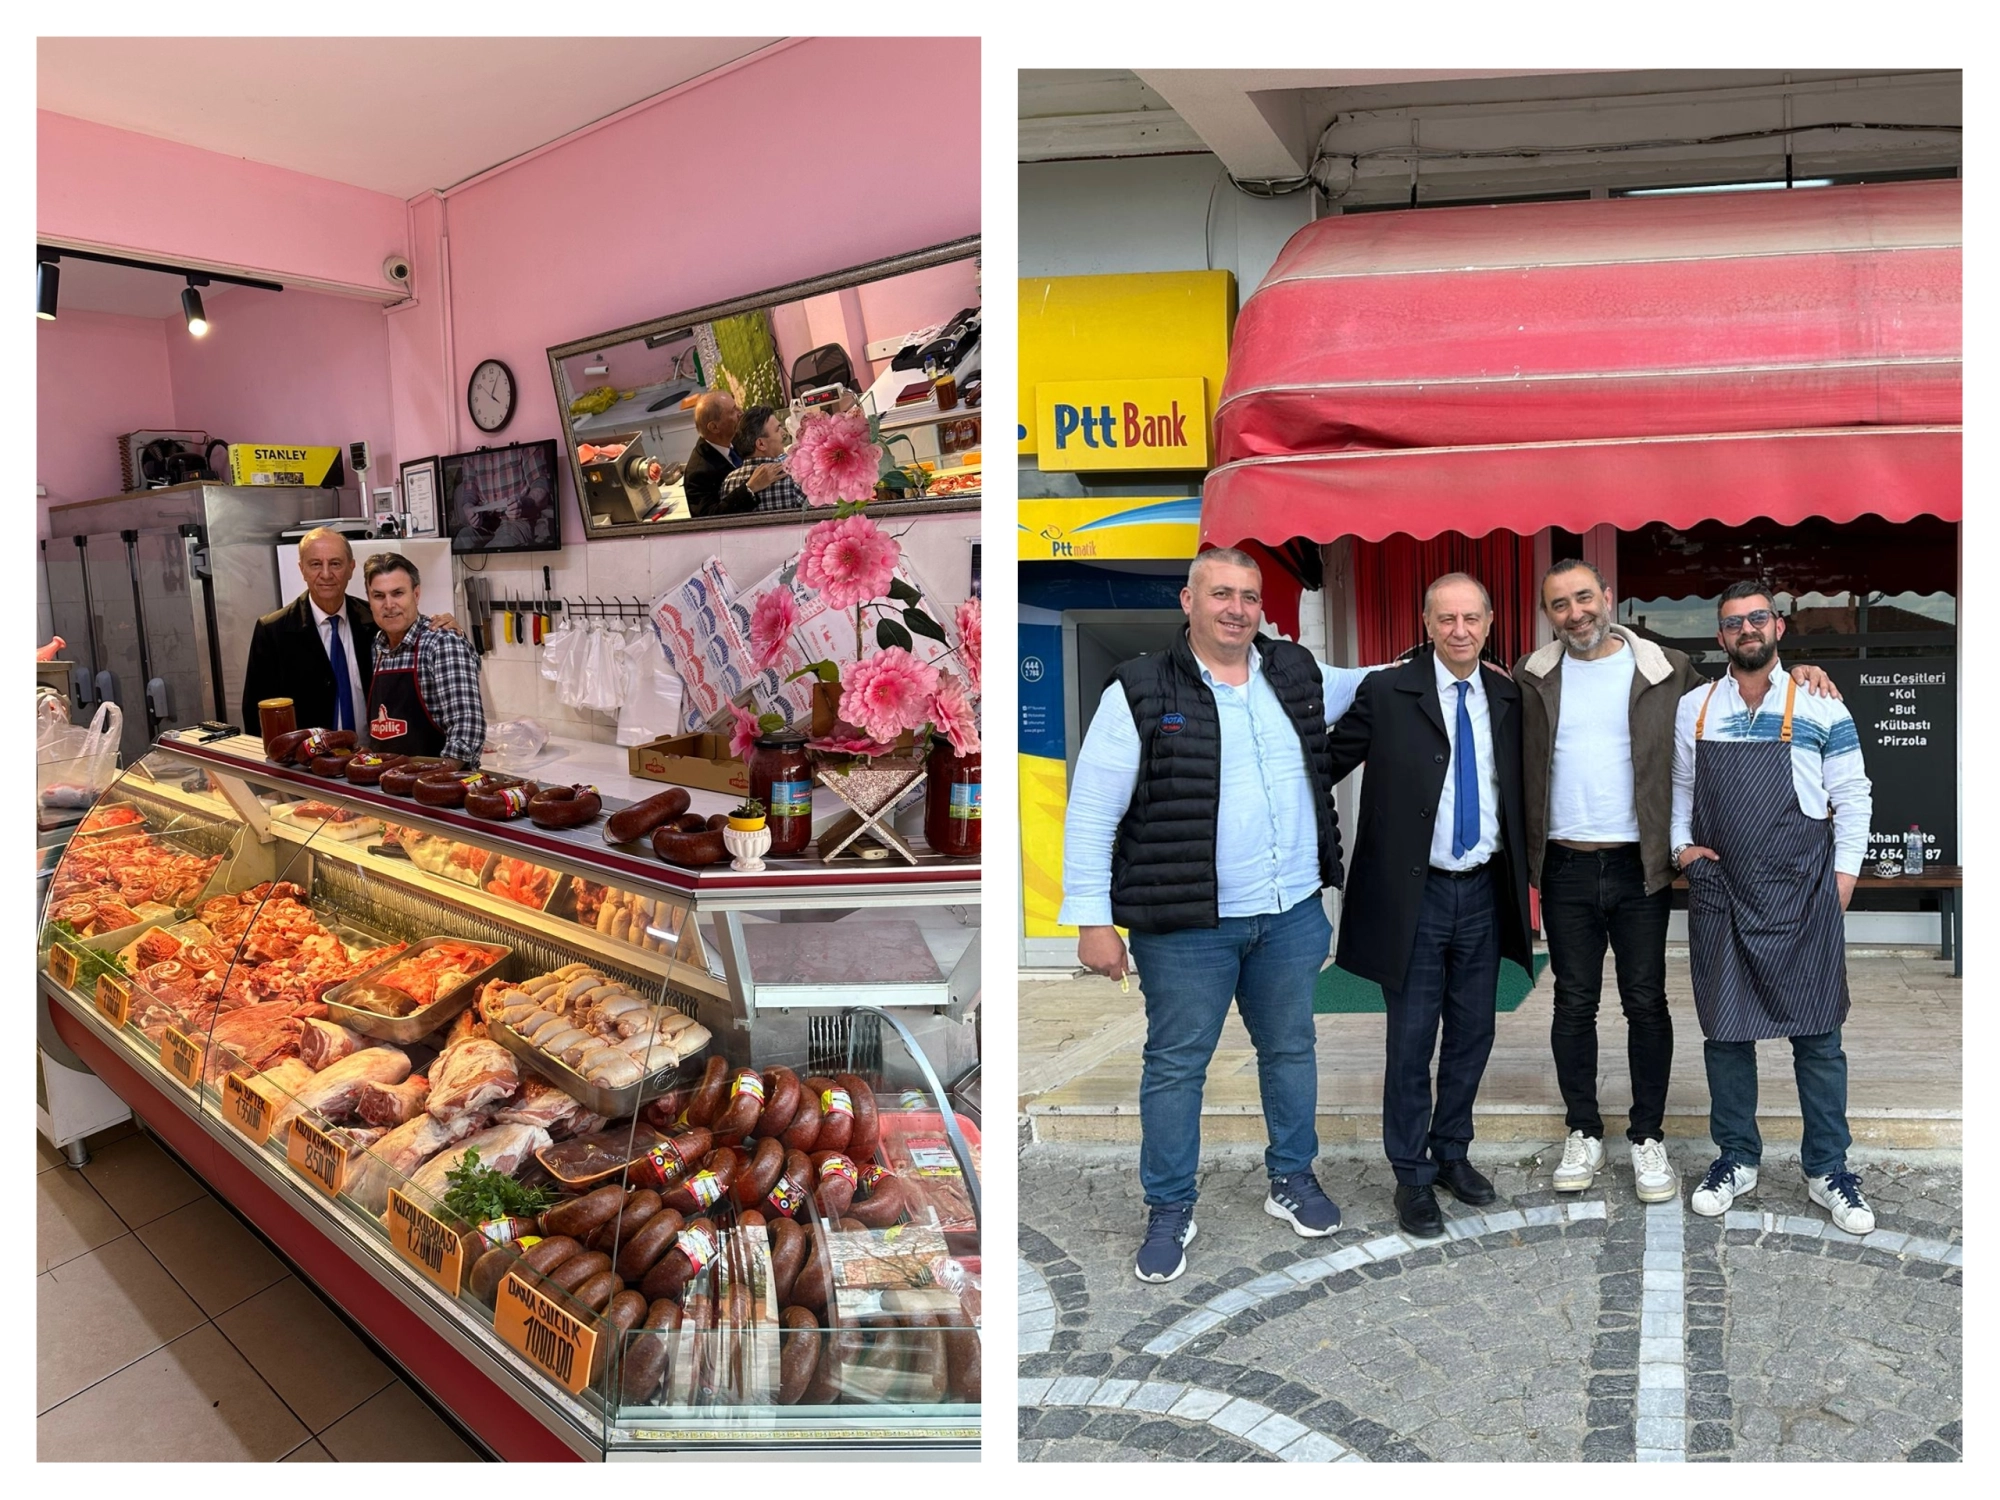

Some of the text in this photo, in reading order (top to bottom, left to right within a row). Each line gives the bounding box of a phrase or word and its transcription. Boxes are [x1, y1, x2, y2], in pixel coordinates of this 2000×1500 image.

[254, 449, 307, 460] STANLEY
[1025, 661, 1039, 670] 444
[1860, 672, 1946, 684] Kuzu Çeşitleri
[1880, 849, 1904, 860] 654
[1925, 849, 1942, 860] 87
[296, 1118, 312, 1143] KUZU
[393, 1192, 416, 1227] KUZU
[508, 1276, 582, 1348] DANA SUCUK
[523, 1315, 574, 1384] 1000.00
